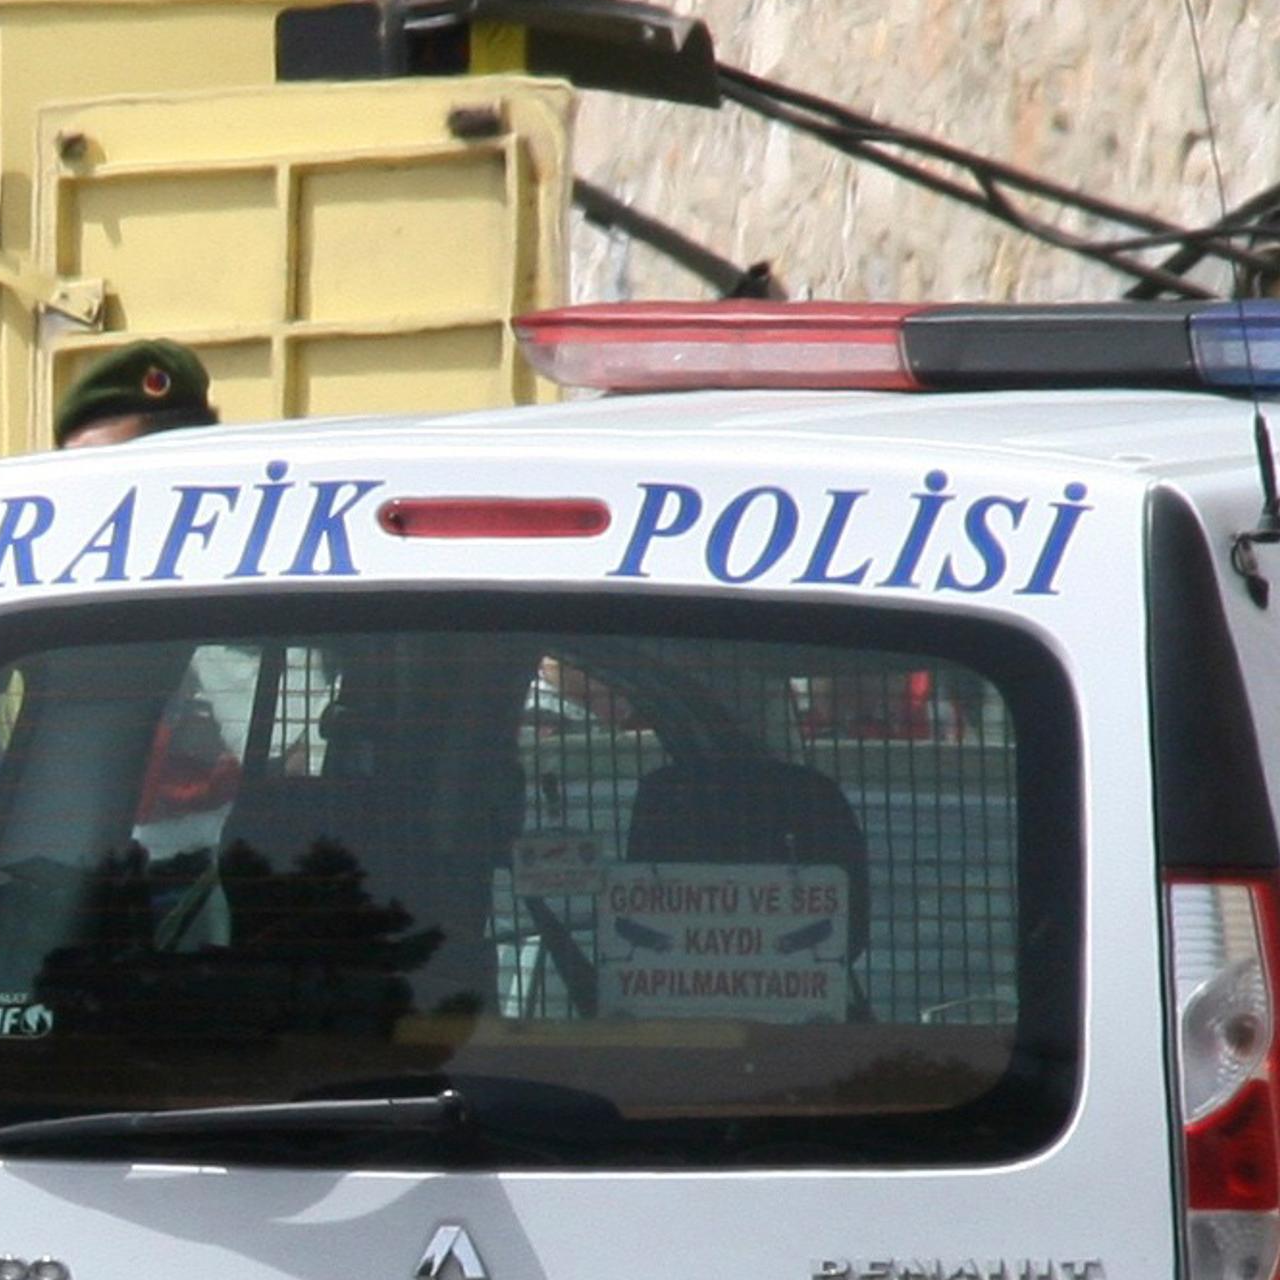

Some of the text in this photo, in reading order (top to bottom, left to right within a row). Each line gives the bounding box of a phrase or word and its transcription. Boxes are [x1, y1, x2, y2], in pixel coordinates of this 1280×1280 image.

[605, 469, 1094, 596] POLİSİ
[609, 879, 740, 915] GÖRÜNTÜ
[749, 884, 780, 914] VE
[792, 884, 838, 913] SES
[685, 926, 763, 956] KAYDI
[619, 970, 828, 999] YAPILMAKTADIR
